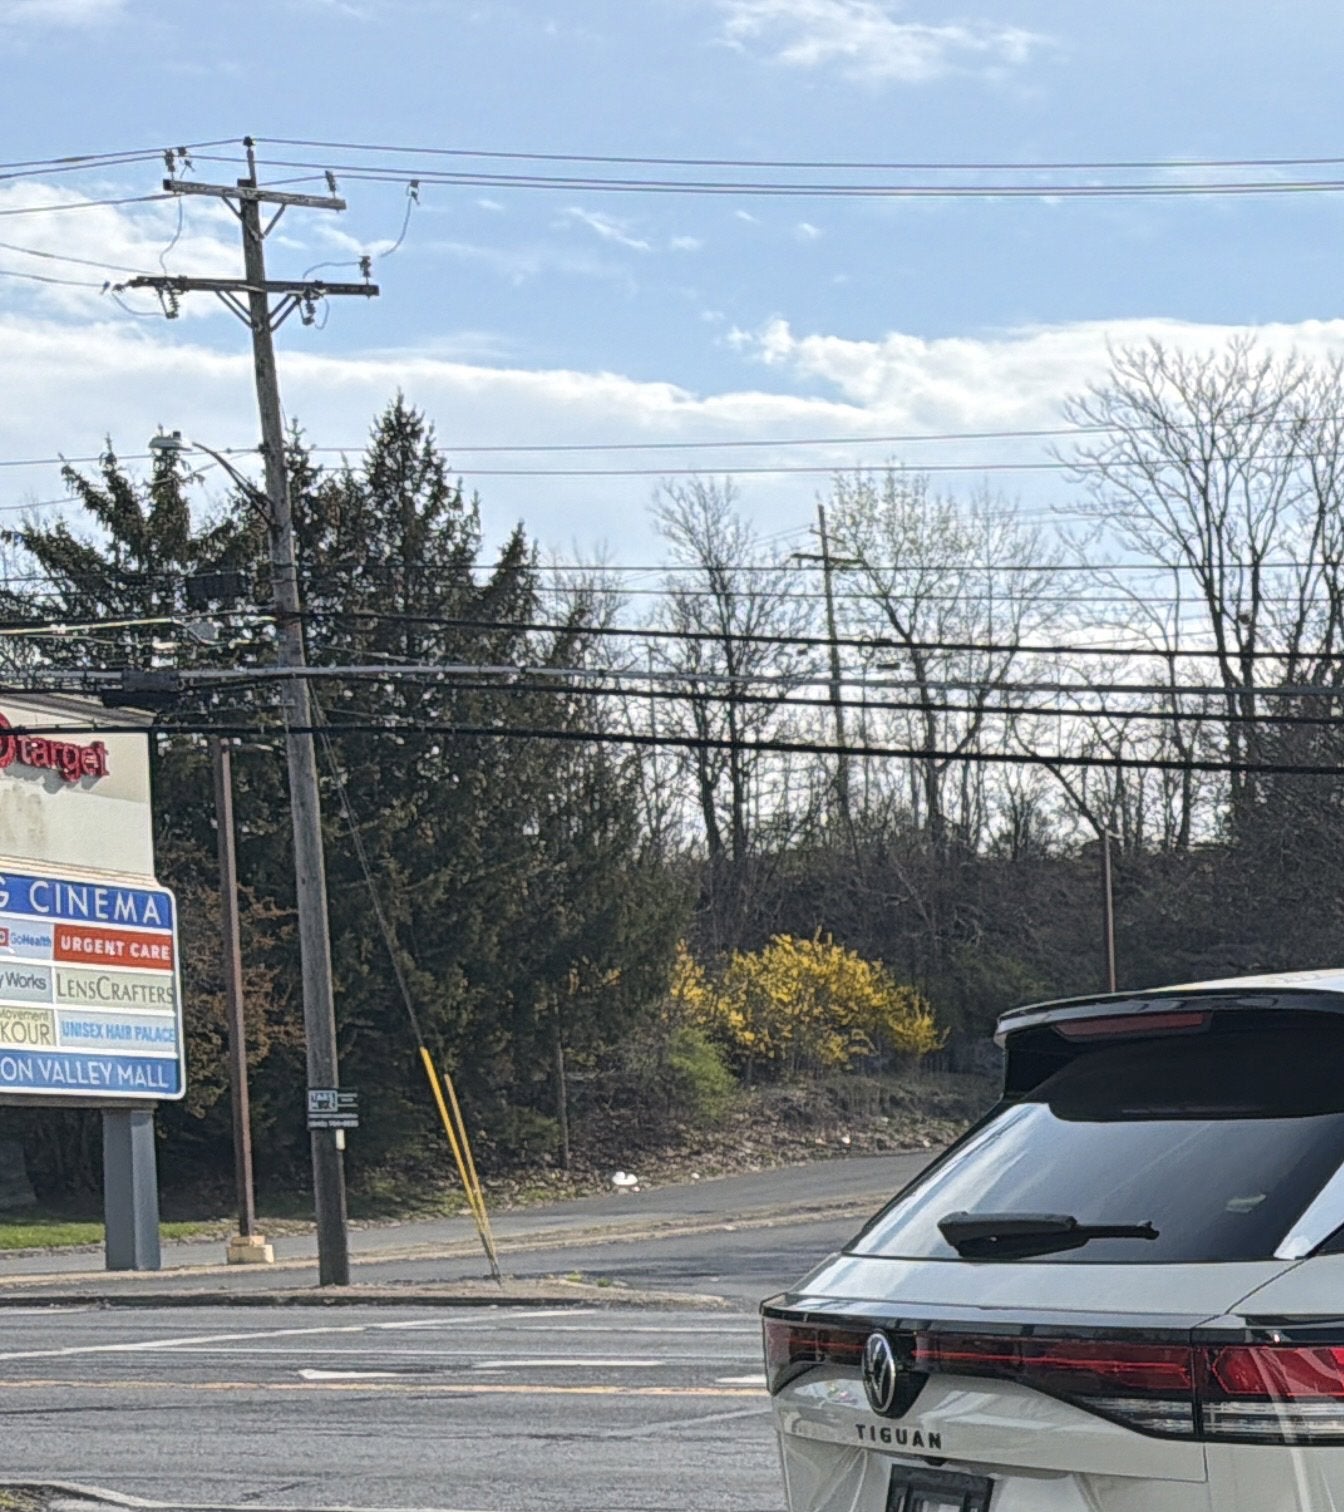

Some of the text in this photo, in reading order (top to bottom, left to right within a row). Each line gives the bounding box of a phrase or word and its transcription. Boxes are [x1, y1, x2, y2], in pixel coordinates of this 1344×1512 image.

[18, 735, 110, 783] target
[29, 880, 162, 925] CINEMA
[61, 935, 171, 961] URGENT CARE
[4, 970, 48, 991] Works
[0, 1020, 52, 1045] KOUR
[61, 1020, 176, 1043] UNISEX HAIR PALACE
[0, 1056, 170, 1088] ON VALLEY MALL
[855, 1423, 942, 1450] TIGUAN
